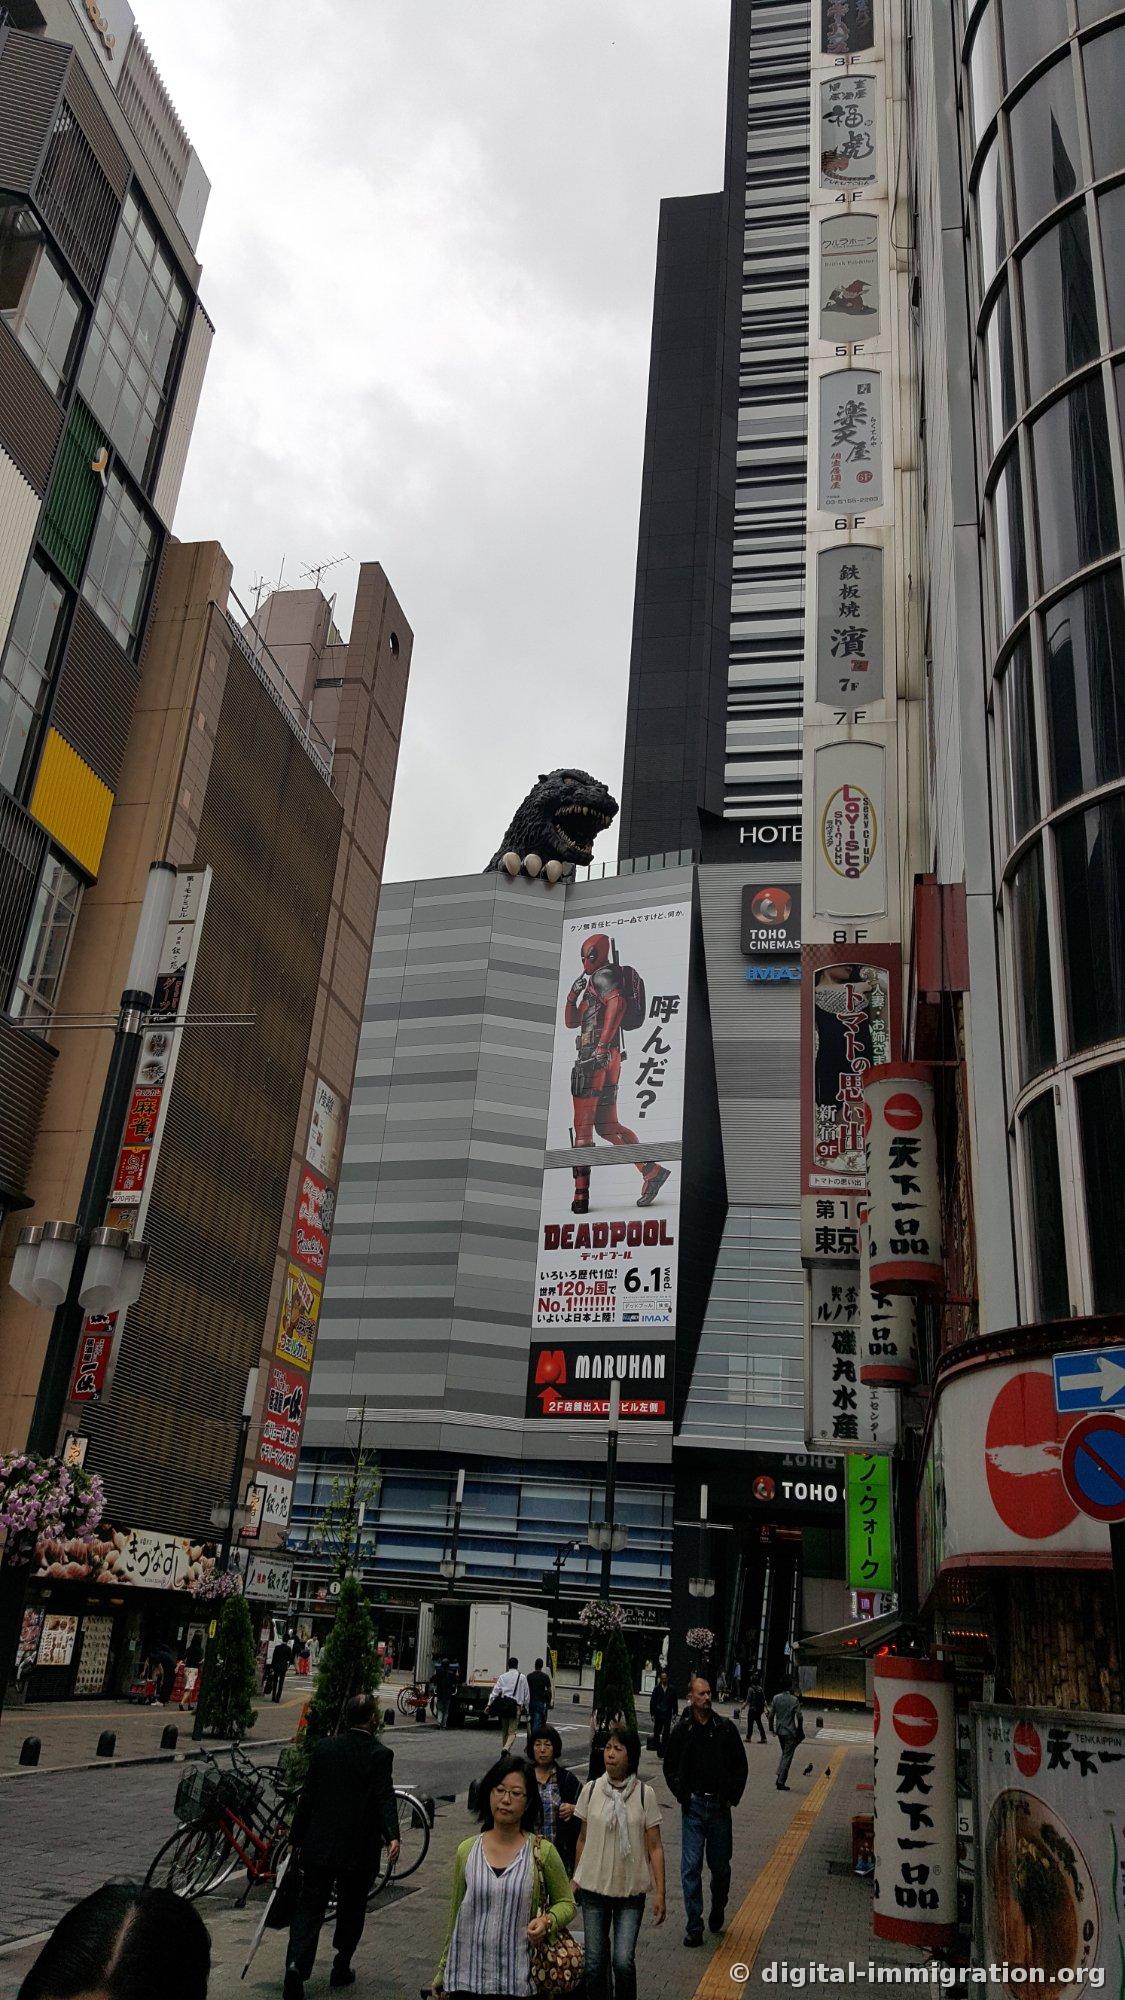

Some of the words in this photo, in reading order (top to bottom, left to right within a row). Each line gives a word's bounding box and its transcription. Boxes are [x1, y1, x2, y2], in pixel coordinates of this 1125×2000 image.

[834, 191, 864, 202] 4F
[835, 344, 865, 356] 5F
[834, 516, 866, 530] 6F
[839, 678, 860, 692] 7F
[833, 711, 866, 725] 7F
[750, 929, 787, 940] TOHO
[833, 930, 868, 944] 8F
[749, 940, 801, 950] CINEMAS
[819, 1104, 837, 1141] 新宿
[820, 1145, 837, 1156] 9F
[888, 1137, 930, 1255] 天下一品
[544, 1219, 674, 1250] DEADPOOL
[815, 1226, 860, 1254] 東京
[624, 1267, 661, 1293] 6.1
[537, 1312, 615, 1323] いよいよ日本上陸!
[817, 1303, 861, 1321] ルノア
[575, 1355, 665, 1379] MARUHAN
[831, 1330, 859, 1440] 磯丸水産
[549, 1401, 659, 1413] 2F店舗出入口ビル左側
[781, 1482, 838, 1502] TOHO
[895, 1750, 940, 1910] 天下一品
